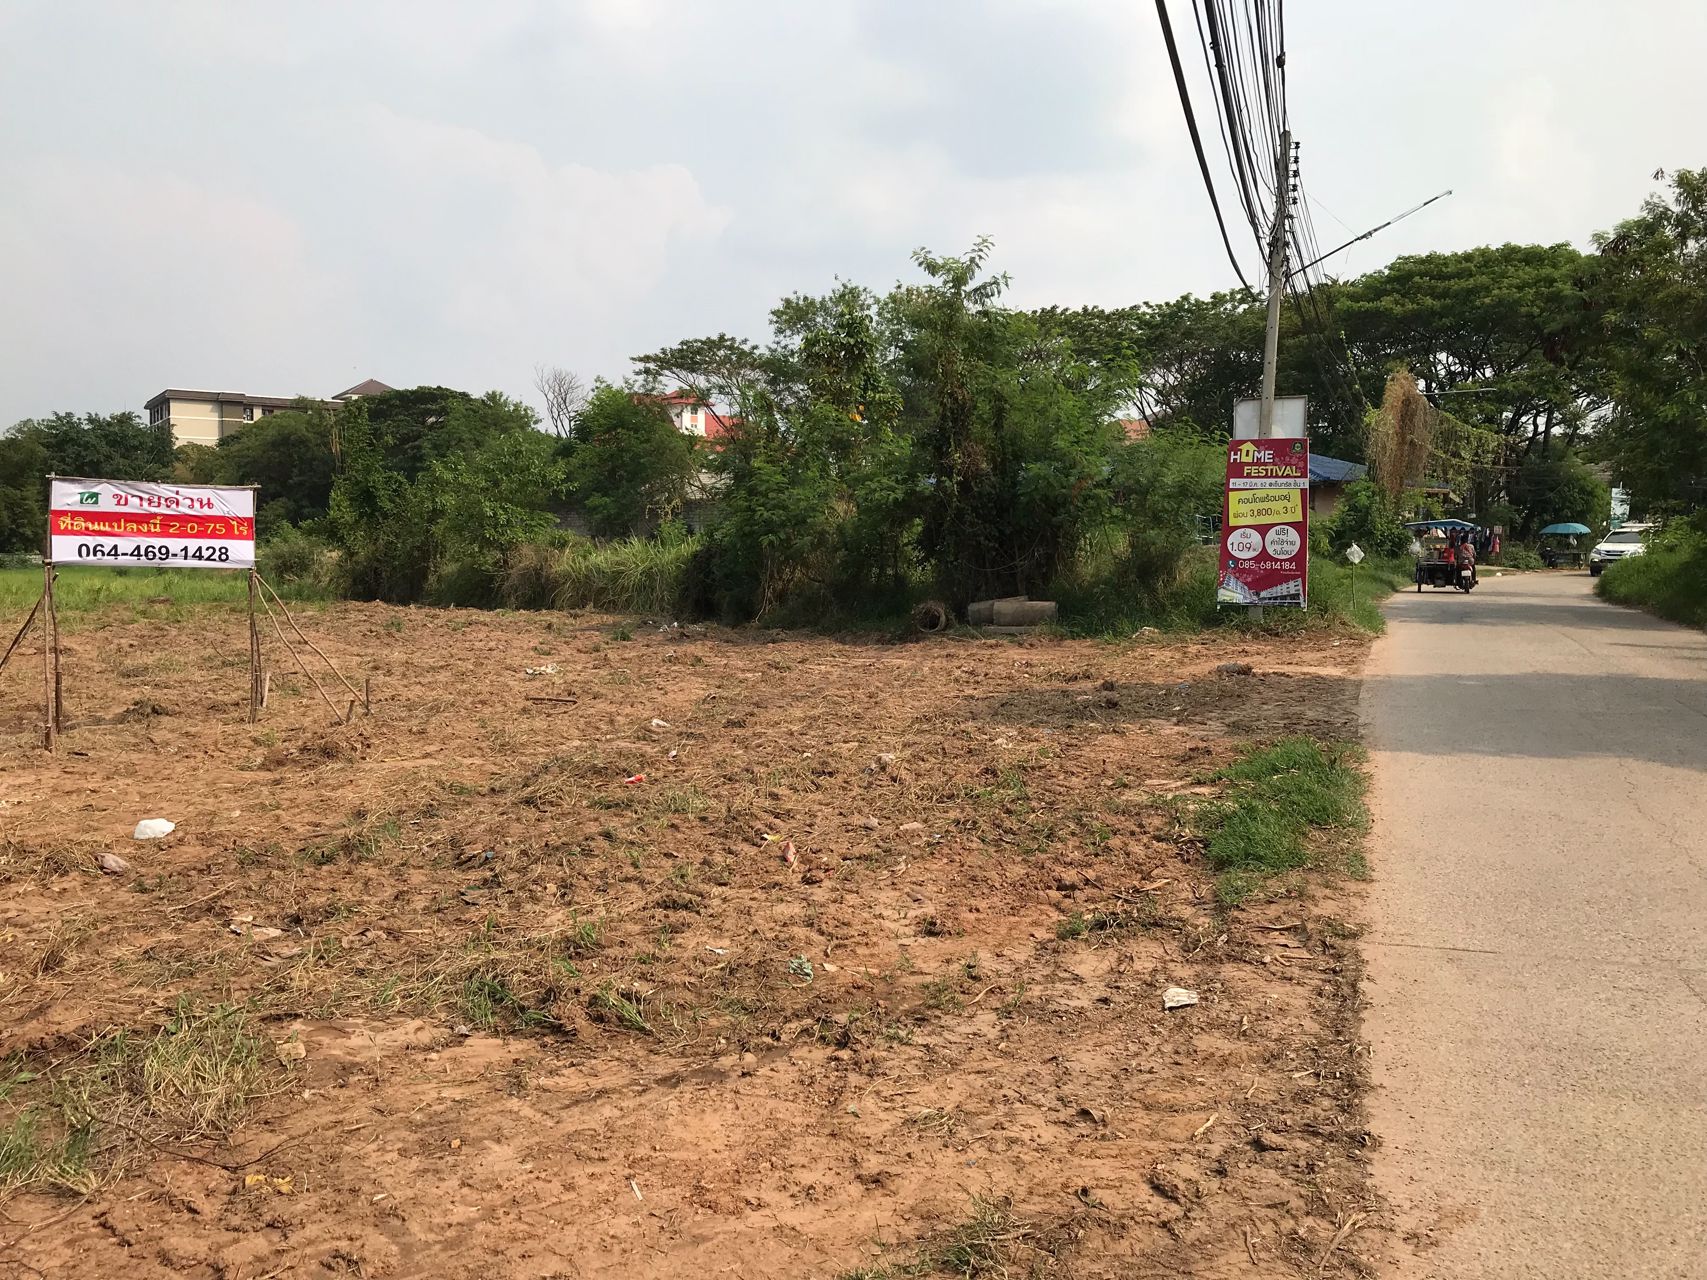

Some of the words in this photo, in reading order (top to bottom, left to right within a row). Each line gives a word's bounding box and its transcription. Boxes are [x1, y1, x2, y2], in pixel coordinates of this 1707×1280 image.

[1230, 442, 1273, 463] HOME
[1243, 465, 1301, 476] FESTIVAL
[112, 490, 214, 510] ขายด่วน
[1238, 492, 1290, 504] คอนโดพร้อมอยู่
[1282, 506, 1289, 514] 3
[58, 512, 164, 533] ที่ดินแปลงนี้
[168, 523, 226, 535] 2-0-75
[231, 519, 249, 536] ไร่
[1240, 528, 1252, 539] เริ่ม
[1275, 527, 1289, 537] ฟรี!
[77, 543, 230, 562] 064-469-1428
[1238, 560, 1297, 570] 085-6814184
